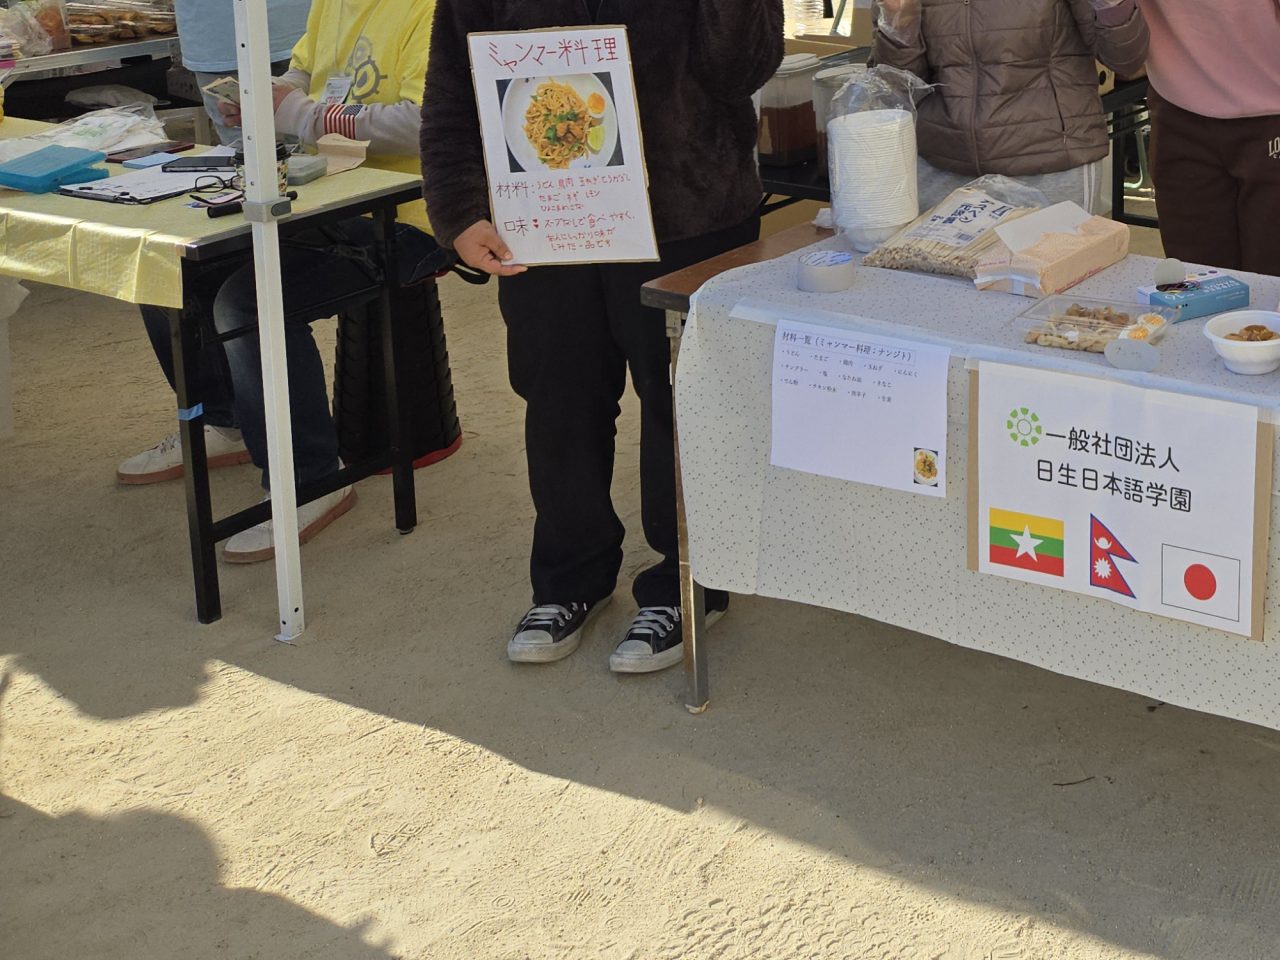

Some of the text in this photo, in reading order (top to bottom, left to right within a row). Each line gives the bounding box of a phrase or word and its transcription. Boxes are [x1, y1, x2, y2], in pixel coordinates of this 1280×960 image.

[488, 37, 619, 73] ミャンマー料理
[1045, 424, 1180, 474] 一般社団法人
[1036, 459, 1192, 514] 日生日本語学園
